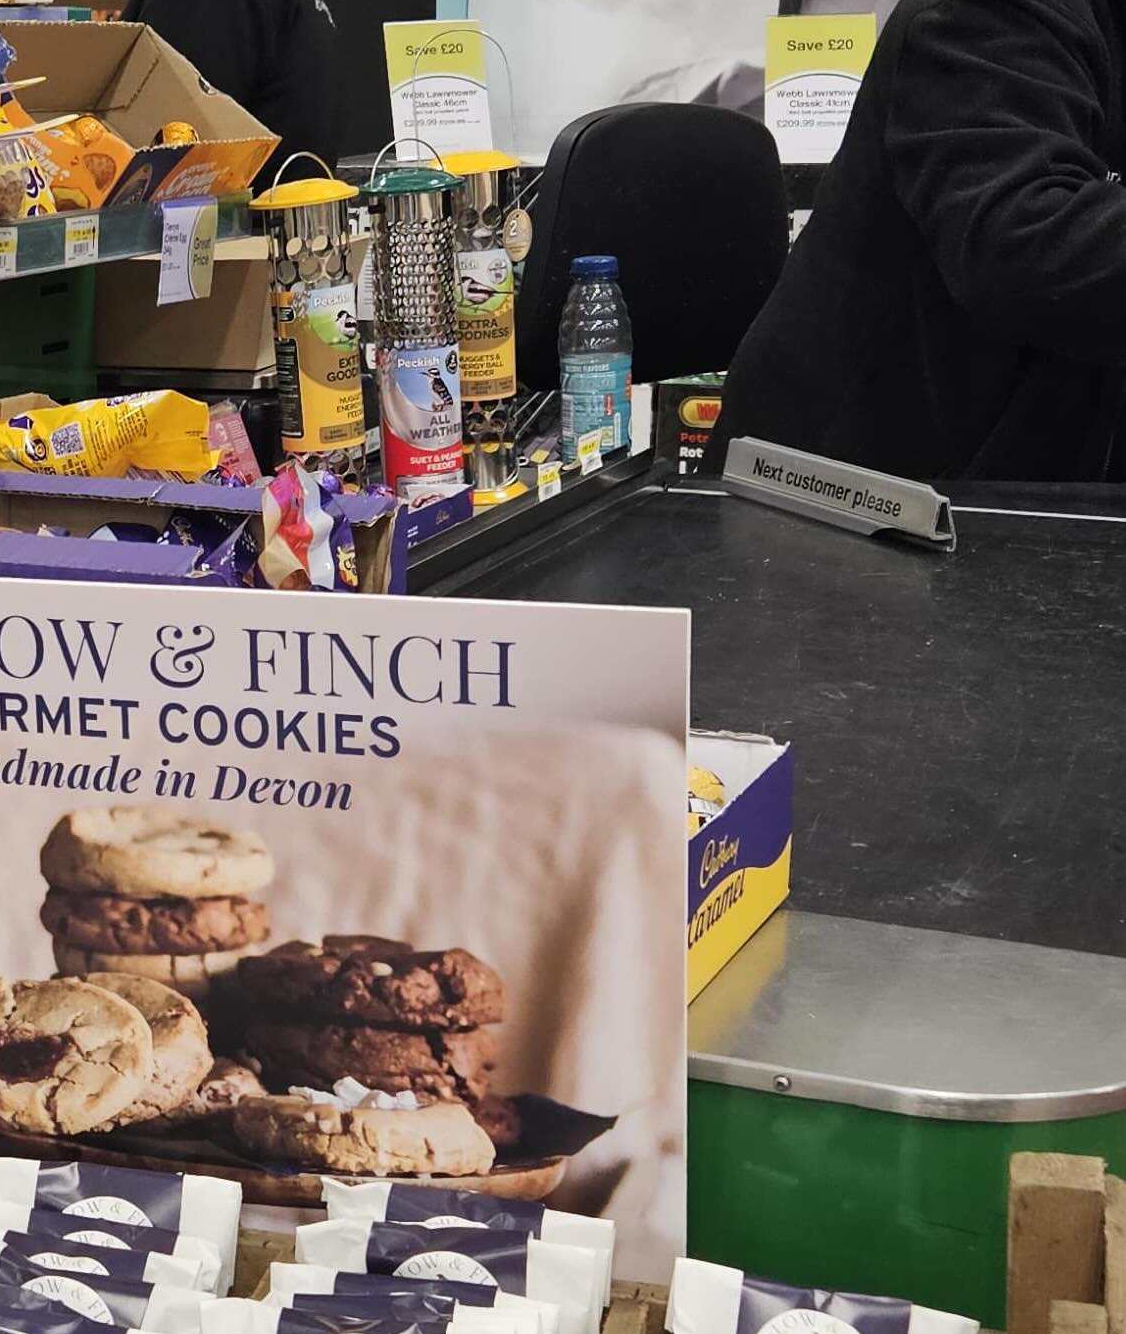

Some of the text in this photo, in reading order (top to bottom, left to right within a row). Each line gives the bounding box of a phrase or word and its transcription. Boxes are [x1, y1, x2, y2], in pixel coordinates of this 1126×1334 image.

[406, 43, 464, 56] Save £20
[787, 39, 854, 51] Save £20
[776, 90, 857, 98] Webb Lawnmow
[789, 100, 822, 108] Classic
[510, 220, 518, 236] 2
[458, 319, 498, 330] EXTRA
[458, 328, 510, 340] OODNESS
[397, 356, 440, 368] Peckish
[327, 369, 360, 382] GOOD
[430, 415, 450, 426] ALL
[410, 423, 461, 439] WEATHE
[680, 432, 709, 444] Petr
[680, 447, 704, 458] Rot
[753, 457, 901, 517] Next customer please
[150, 624, 214, 688] &
[241, 628, 517, 708] FINCH
[159, 703, 401, 759] COOKIES
[155, 760, 196, 799] in
[211, 766, 353, 812] Devon
